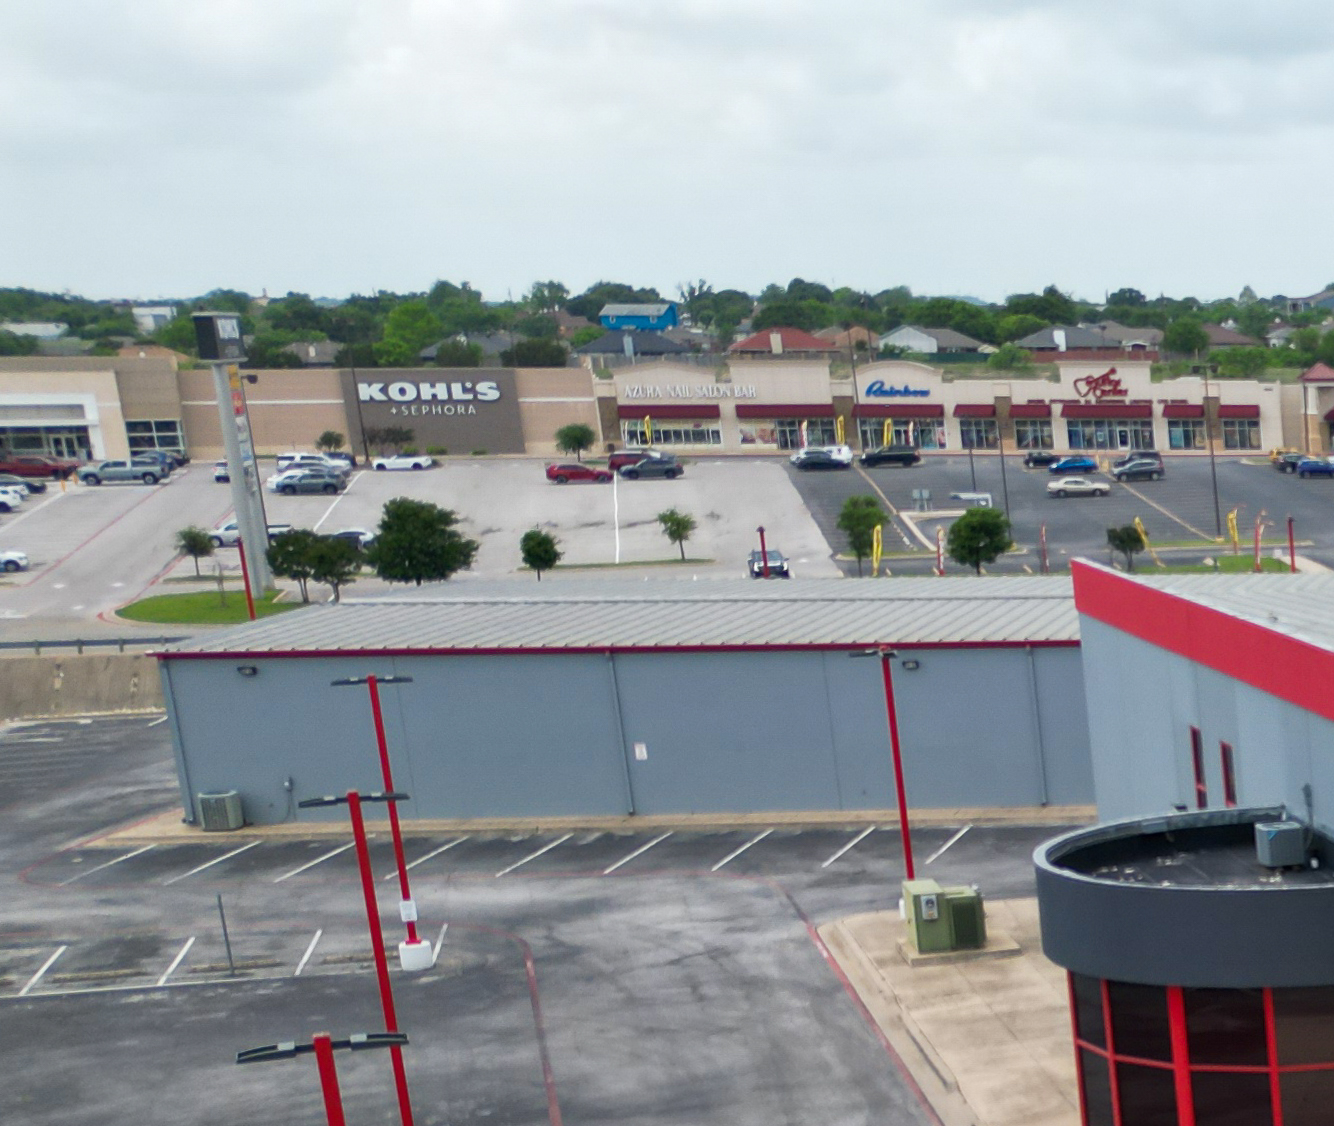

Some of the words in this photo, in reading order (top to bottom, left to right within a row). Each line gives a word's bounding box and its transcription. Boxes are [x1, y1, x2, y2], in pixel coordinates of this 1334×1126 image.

[357, 381, 501, 402] KOHL'S
[666, 385, 692, 398] NAIL
[695, 384, 731, 398] SALON
[734, 384, 757, 398] BAR
[865, 380, 931, 398] Rainbow
